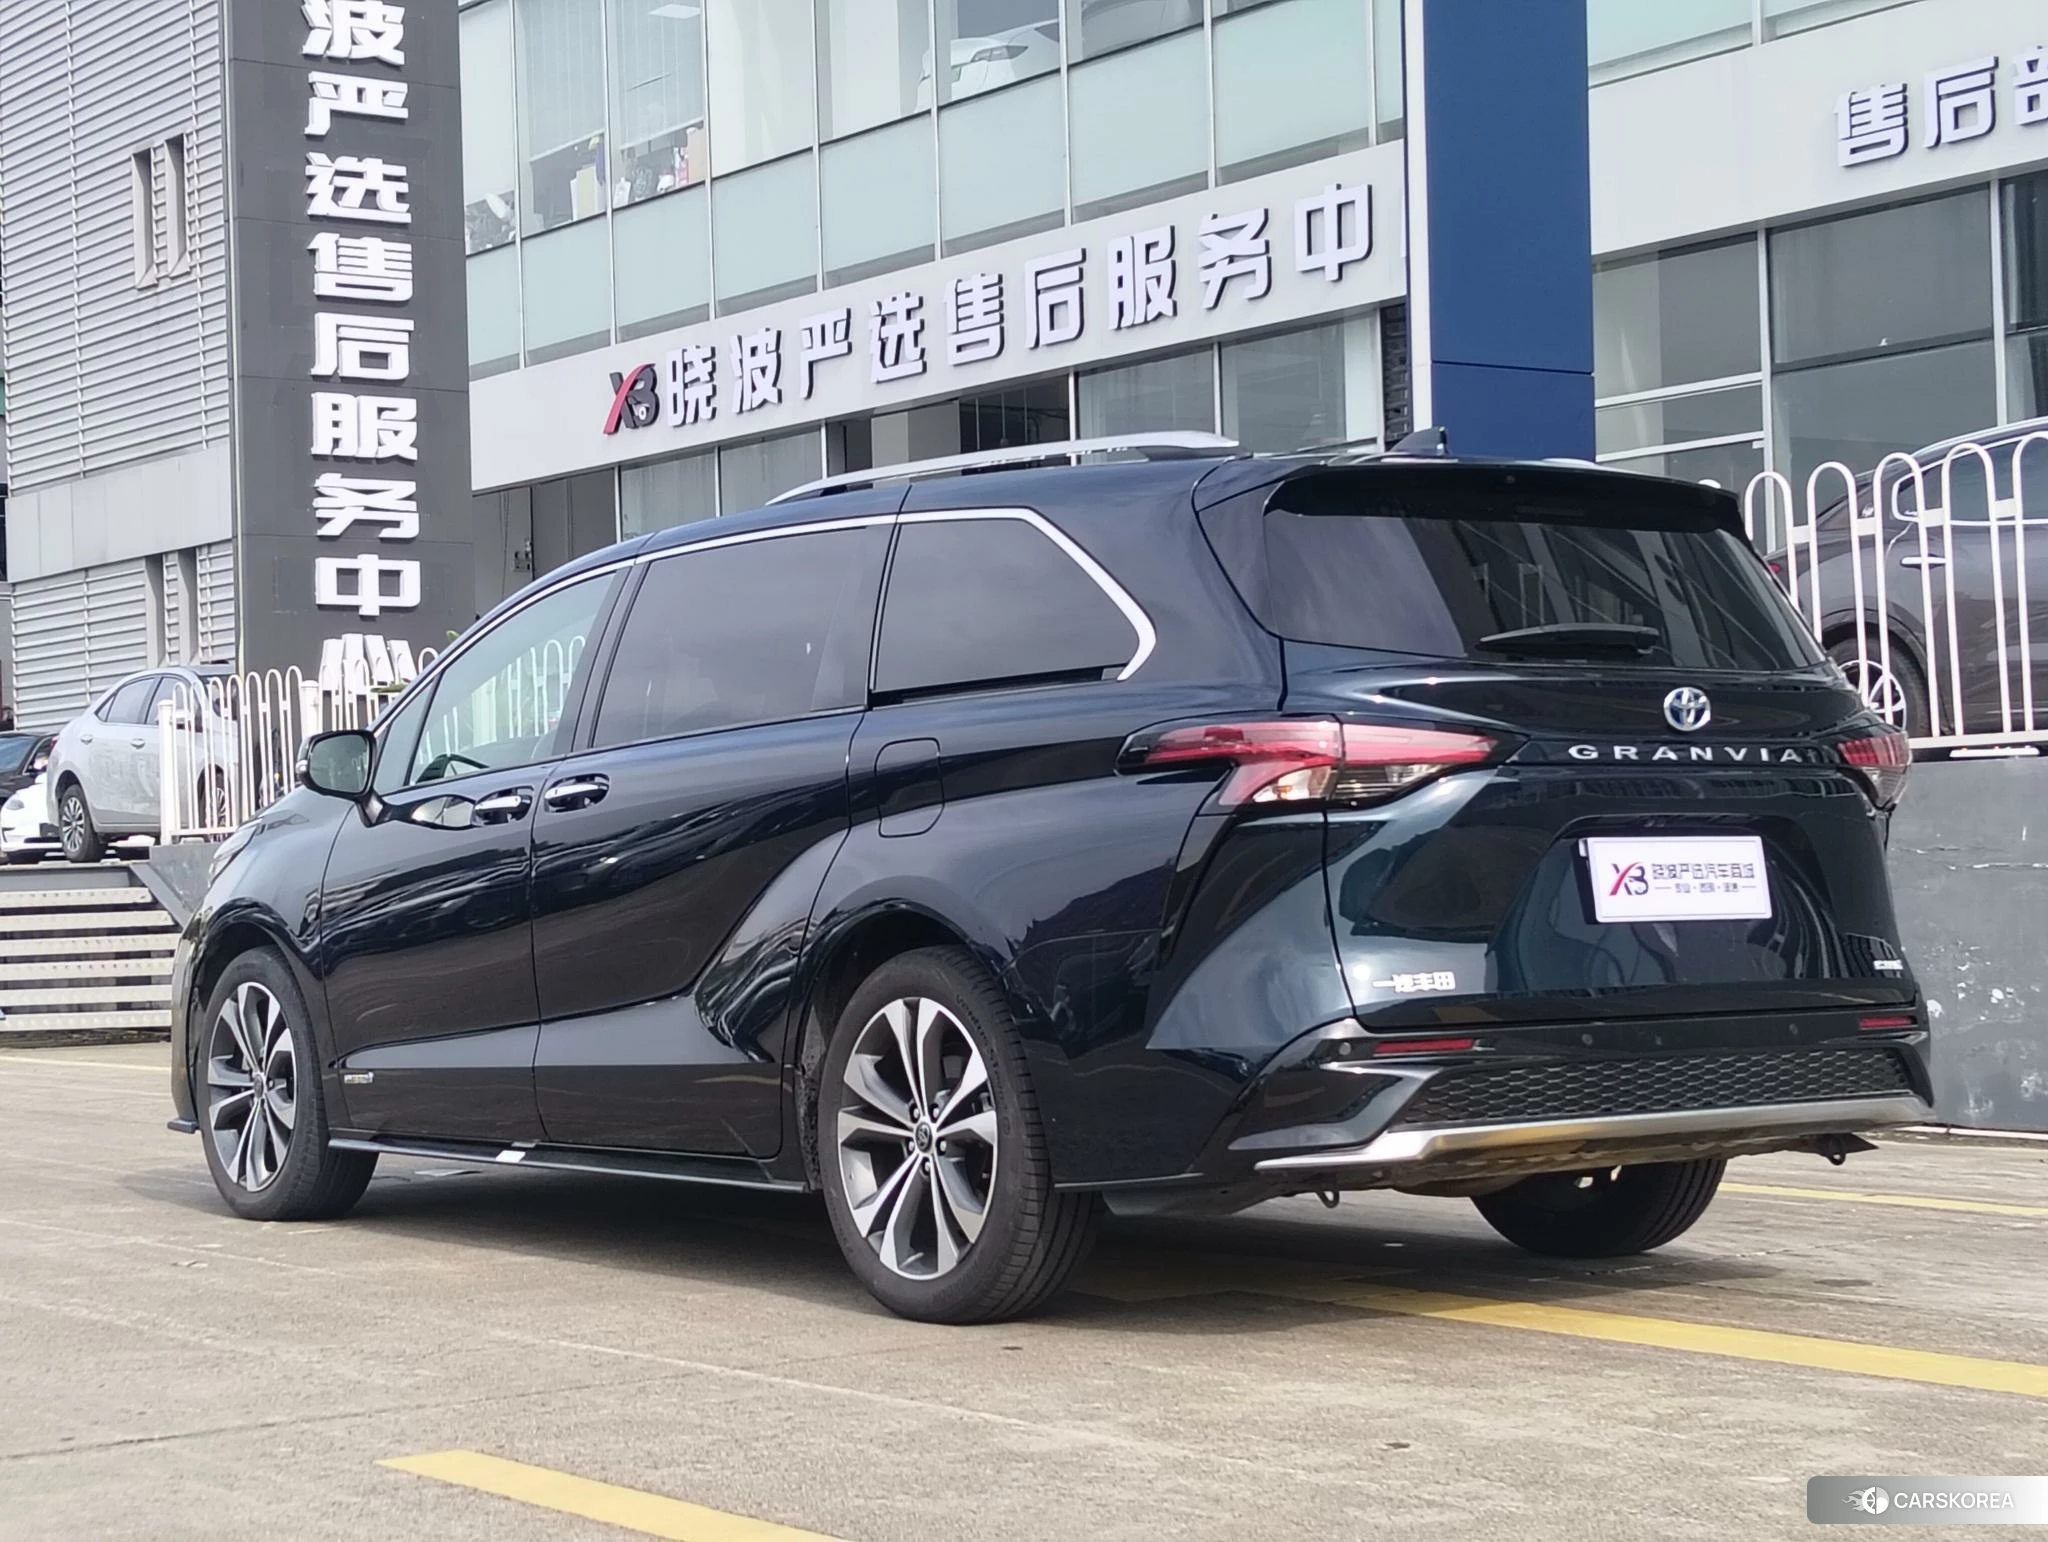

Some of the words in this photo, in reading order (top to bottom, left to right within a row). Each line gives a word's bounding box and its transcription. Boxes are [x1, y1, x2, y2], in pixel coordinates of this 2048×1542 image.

[666, 183, 1406, 427] 晓波严选售后服务中
[1568, 744, 1803, 763] GRANVIA
